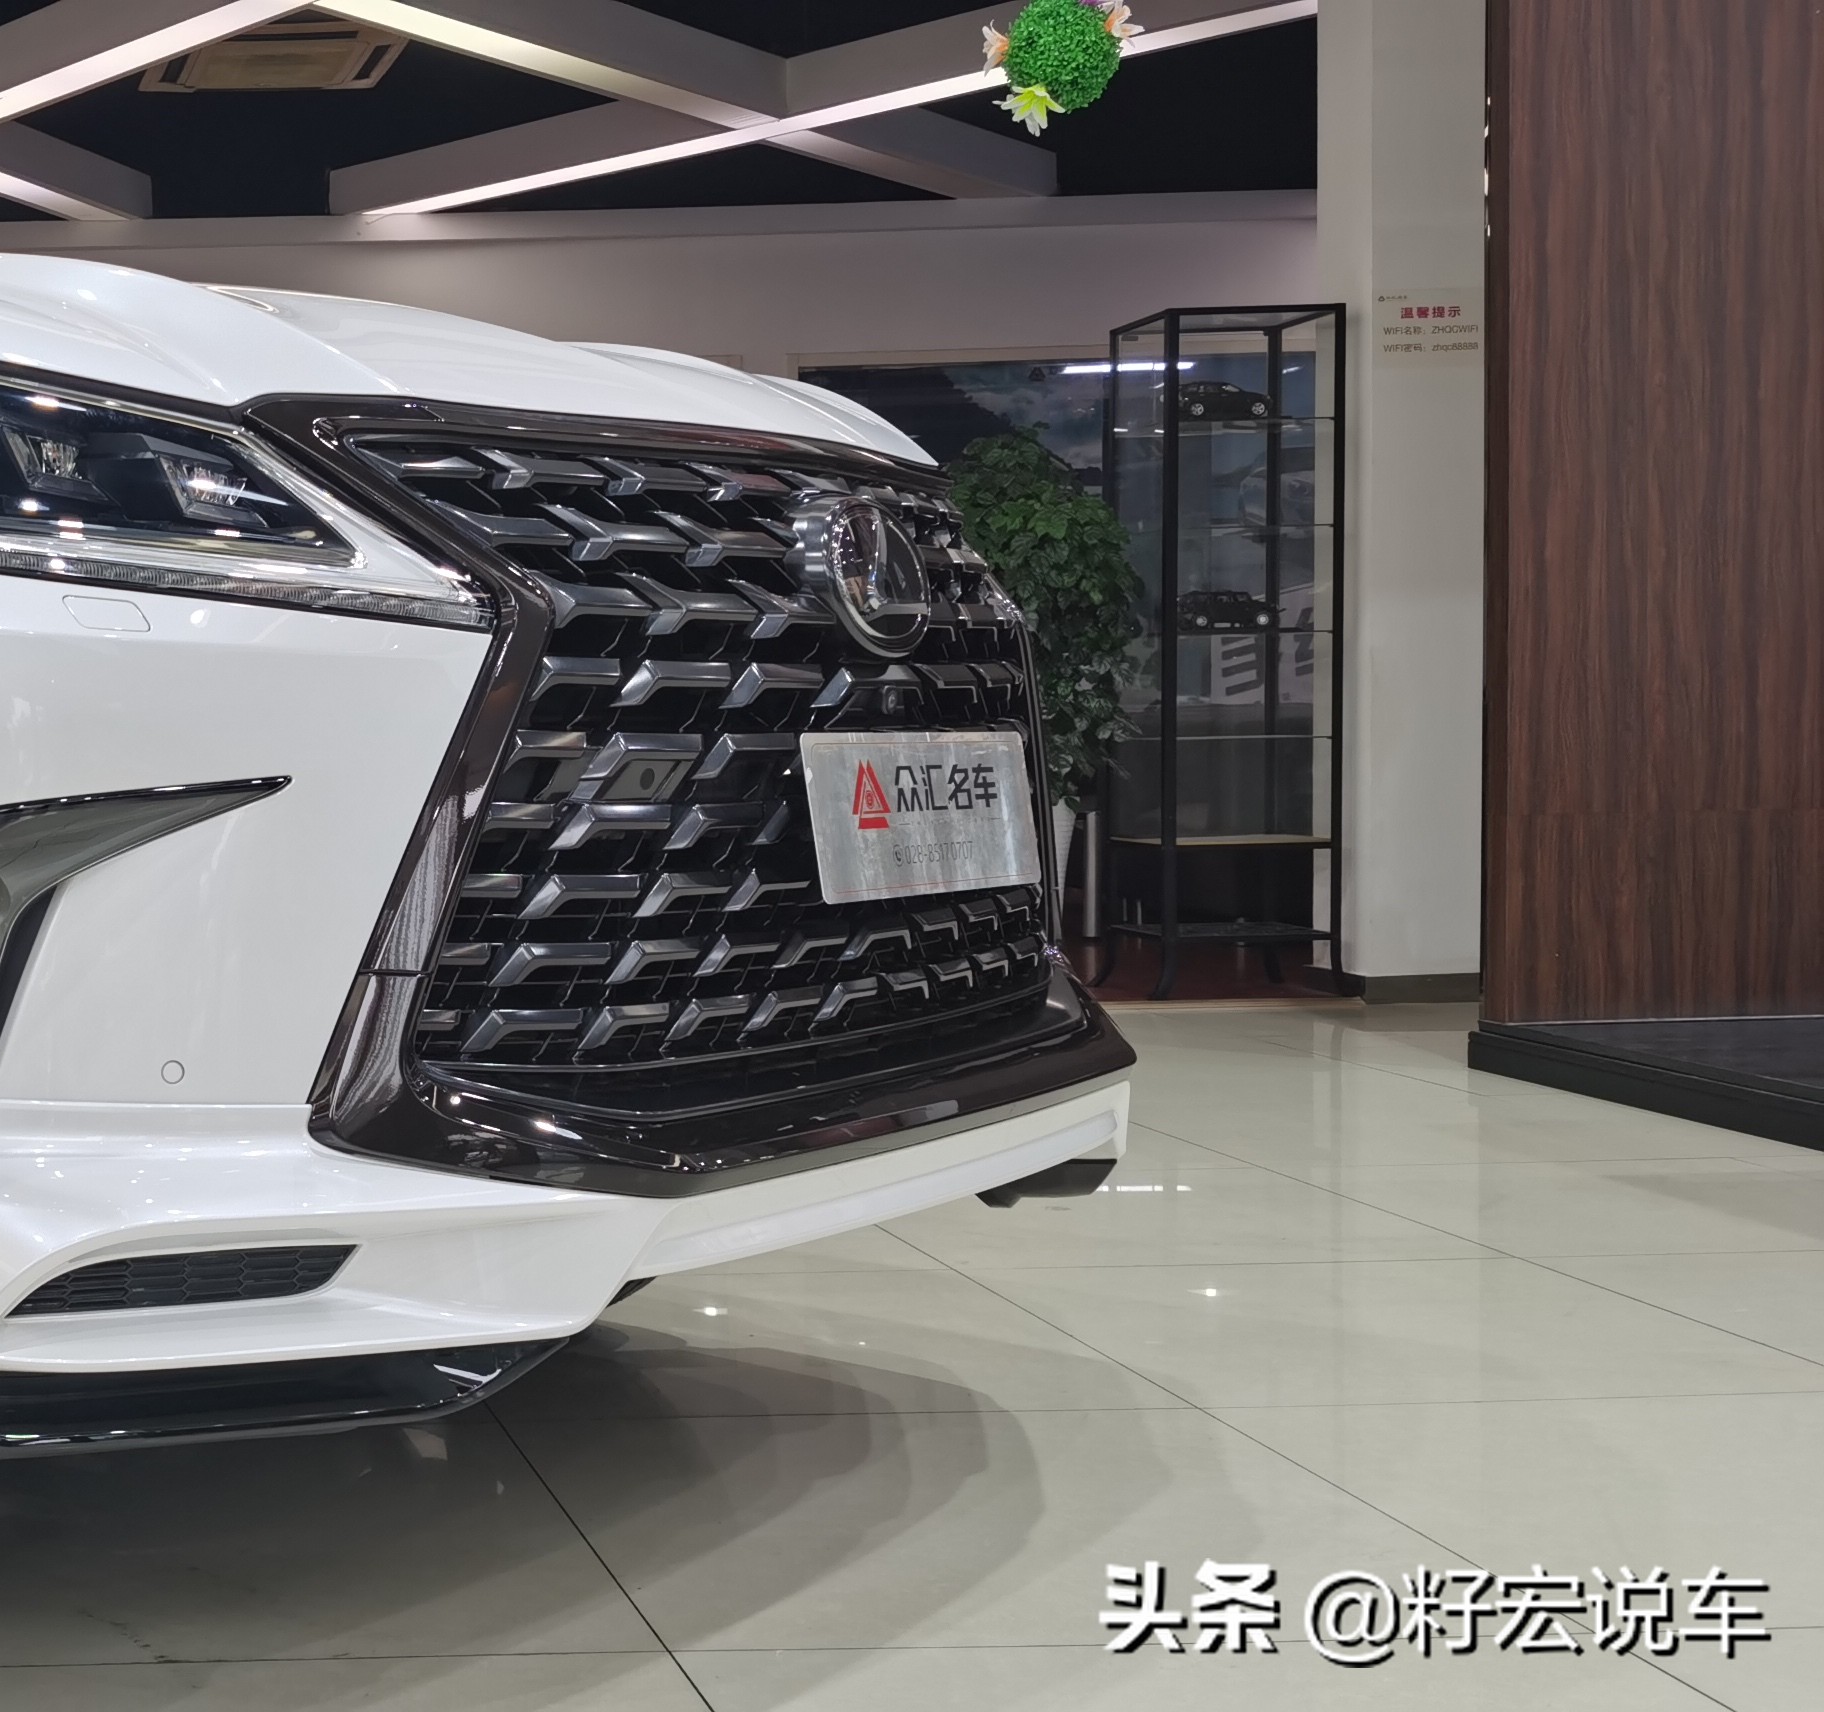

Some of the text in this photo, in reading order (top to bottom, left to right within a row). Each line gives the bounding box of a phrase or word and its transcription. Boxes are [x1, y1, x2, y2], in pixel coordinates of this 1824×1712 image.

[1400, 306, 1461, 319] 温馨提示
[895, 763, 998, 812] 众汇名车
[904, 840, 974, 865] 028-85170707
